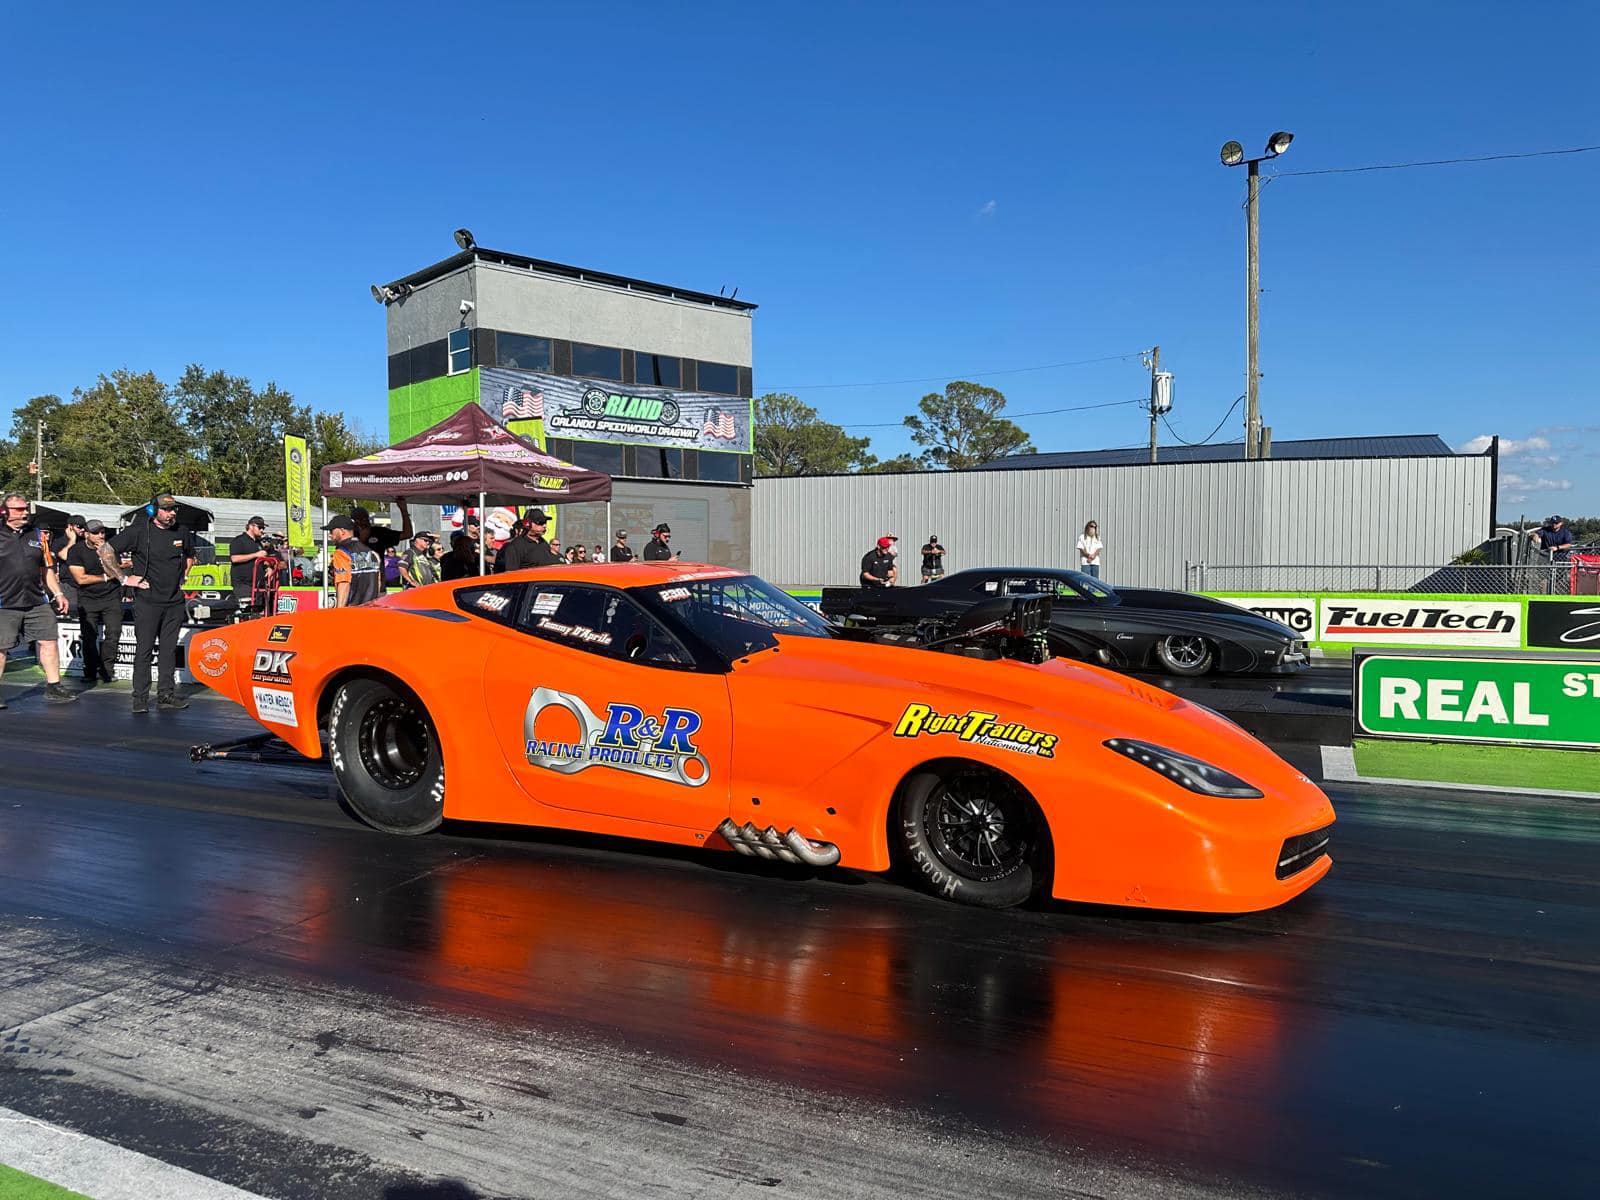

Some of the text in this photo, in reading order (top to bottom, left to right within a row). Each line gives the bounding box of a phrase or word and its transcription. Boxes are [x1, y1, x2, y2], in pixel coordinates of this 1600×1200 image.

[551, 416, 596, 430] ORLANDO
[658, 427, 699, 439] DRAGWAY
[343, 474, 444, 485] www.williesmonstershirts.com
[537, 617, 613, 645] Tommy D'Aprile
[1327, 606, 1516, 633] FuelTech
[253, 649, 296, 674] DK
[1379, 676, 1549, 726] REAL
[596, 702, 702, 755] R&R
[526, 739, 675, 769] RACING PRODUCTS
[976, 735, 1036, 755] Nationwide
